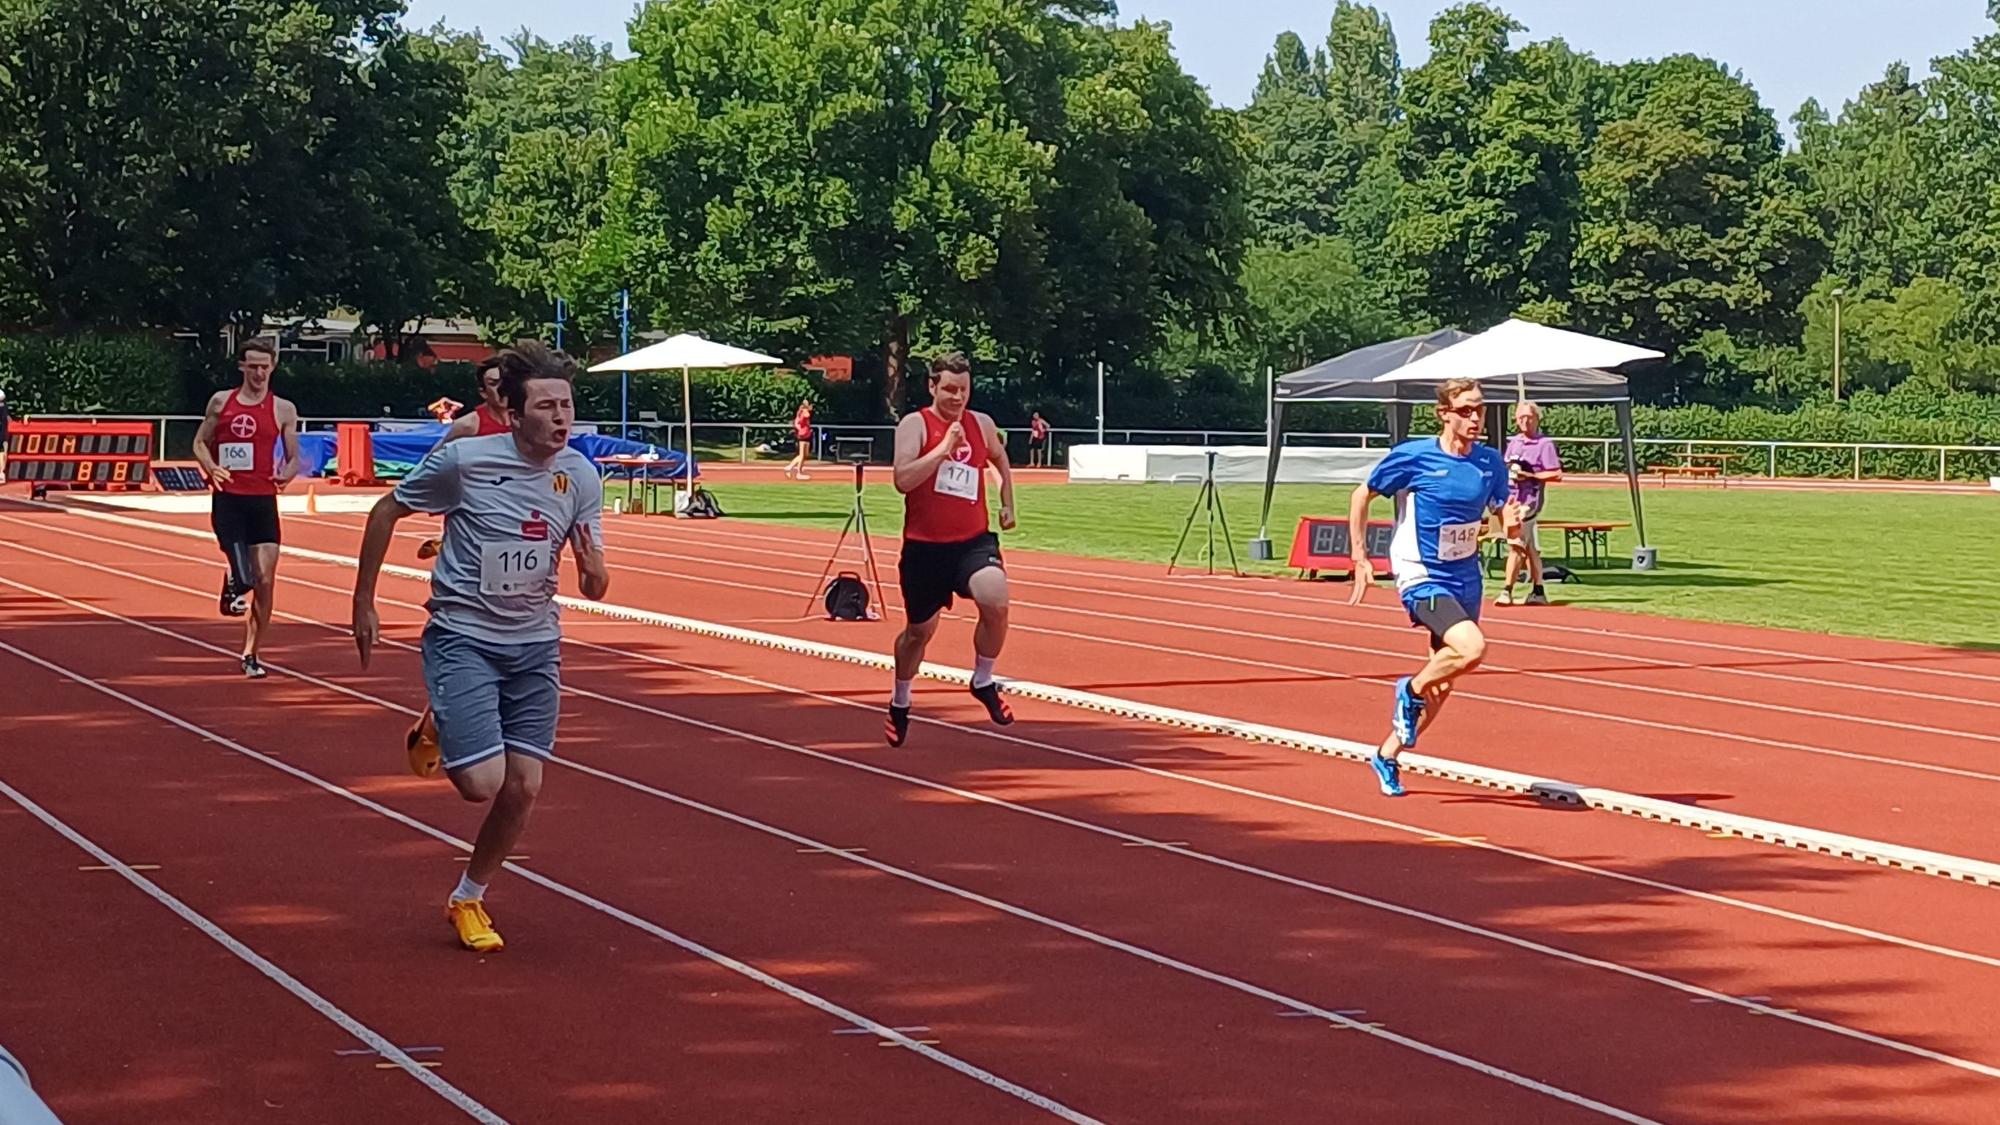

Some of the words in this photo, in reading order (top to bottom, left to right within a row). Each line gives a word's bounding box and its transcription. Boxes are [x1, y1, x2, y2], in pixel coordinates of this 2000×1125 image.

[225, 446, 247, 459] 166
[947, 466, 970, 485] 171
[498, 549, 538, 573] 116
